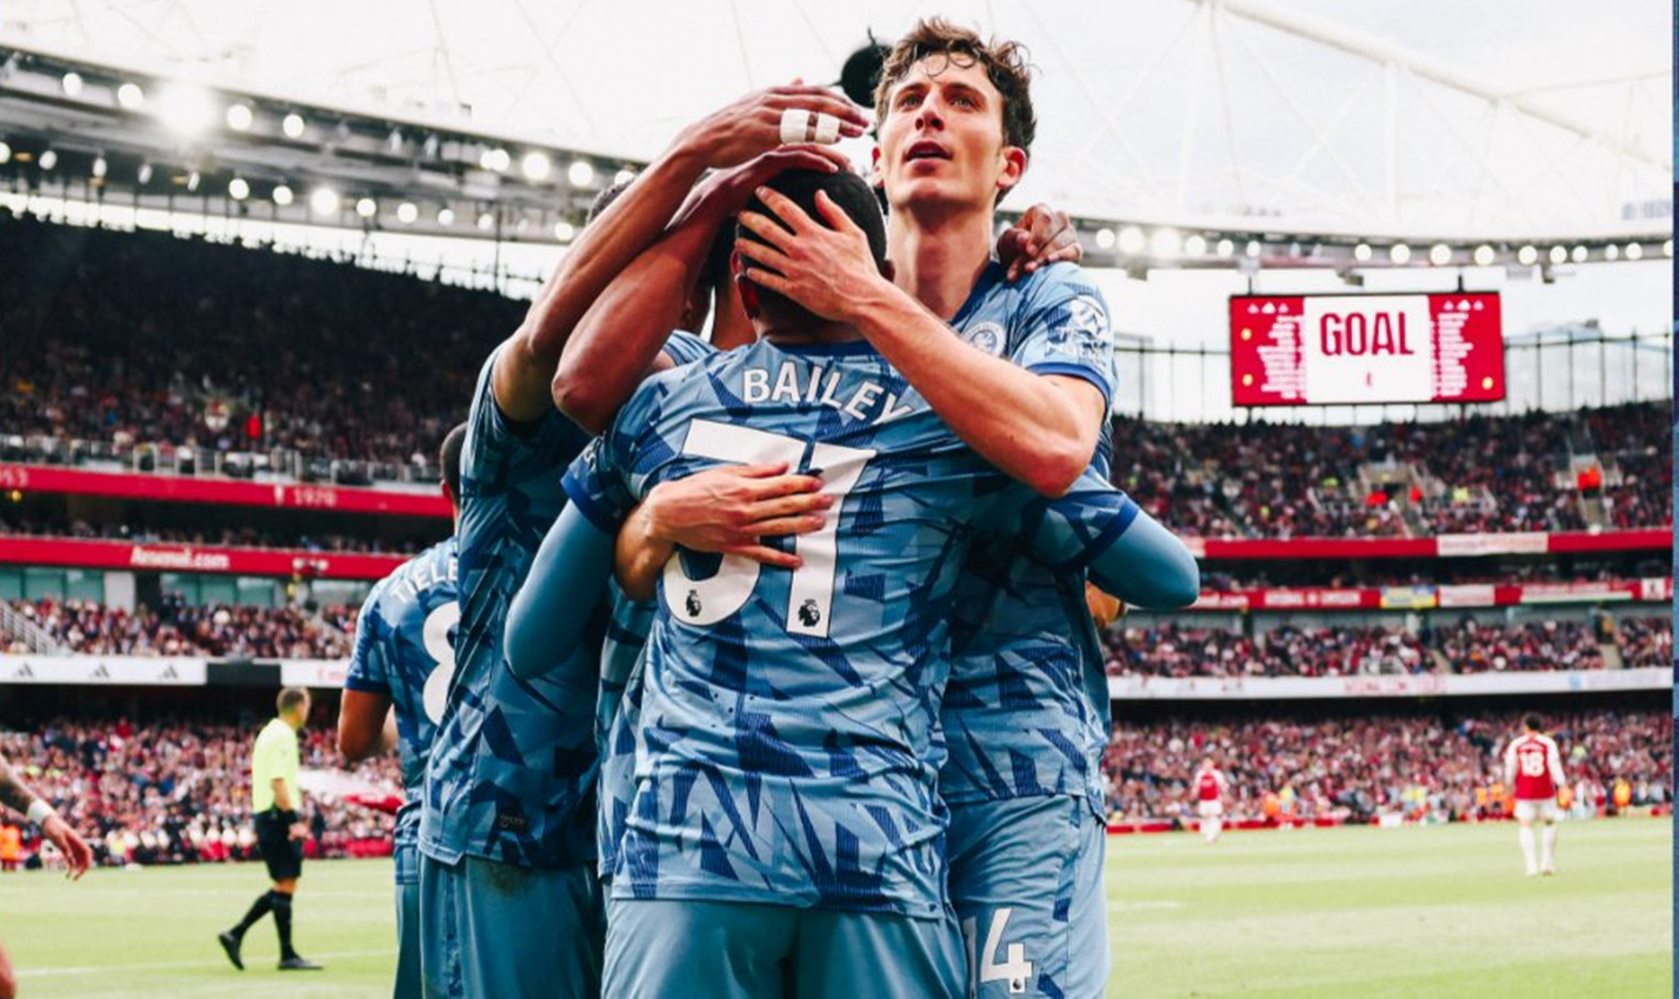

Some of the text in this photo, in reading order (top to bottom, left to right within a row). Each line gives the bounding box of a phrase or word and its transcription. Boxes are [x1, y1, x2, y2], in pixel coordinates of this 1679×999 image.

[1319, 311, 1415, 356] GOAL
[743, 361, 914, 425] BAILEY
[1519, 751, 1546, 778] 18
